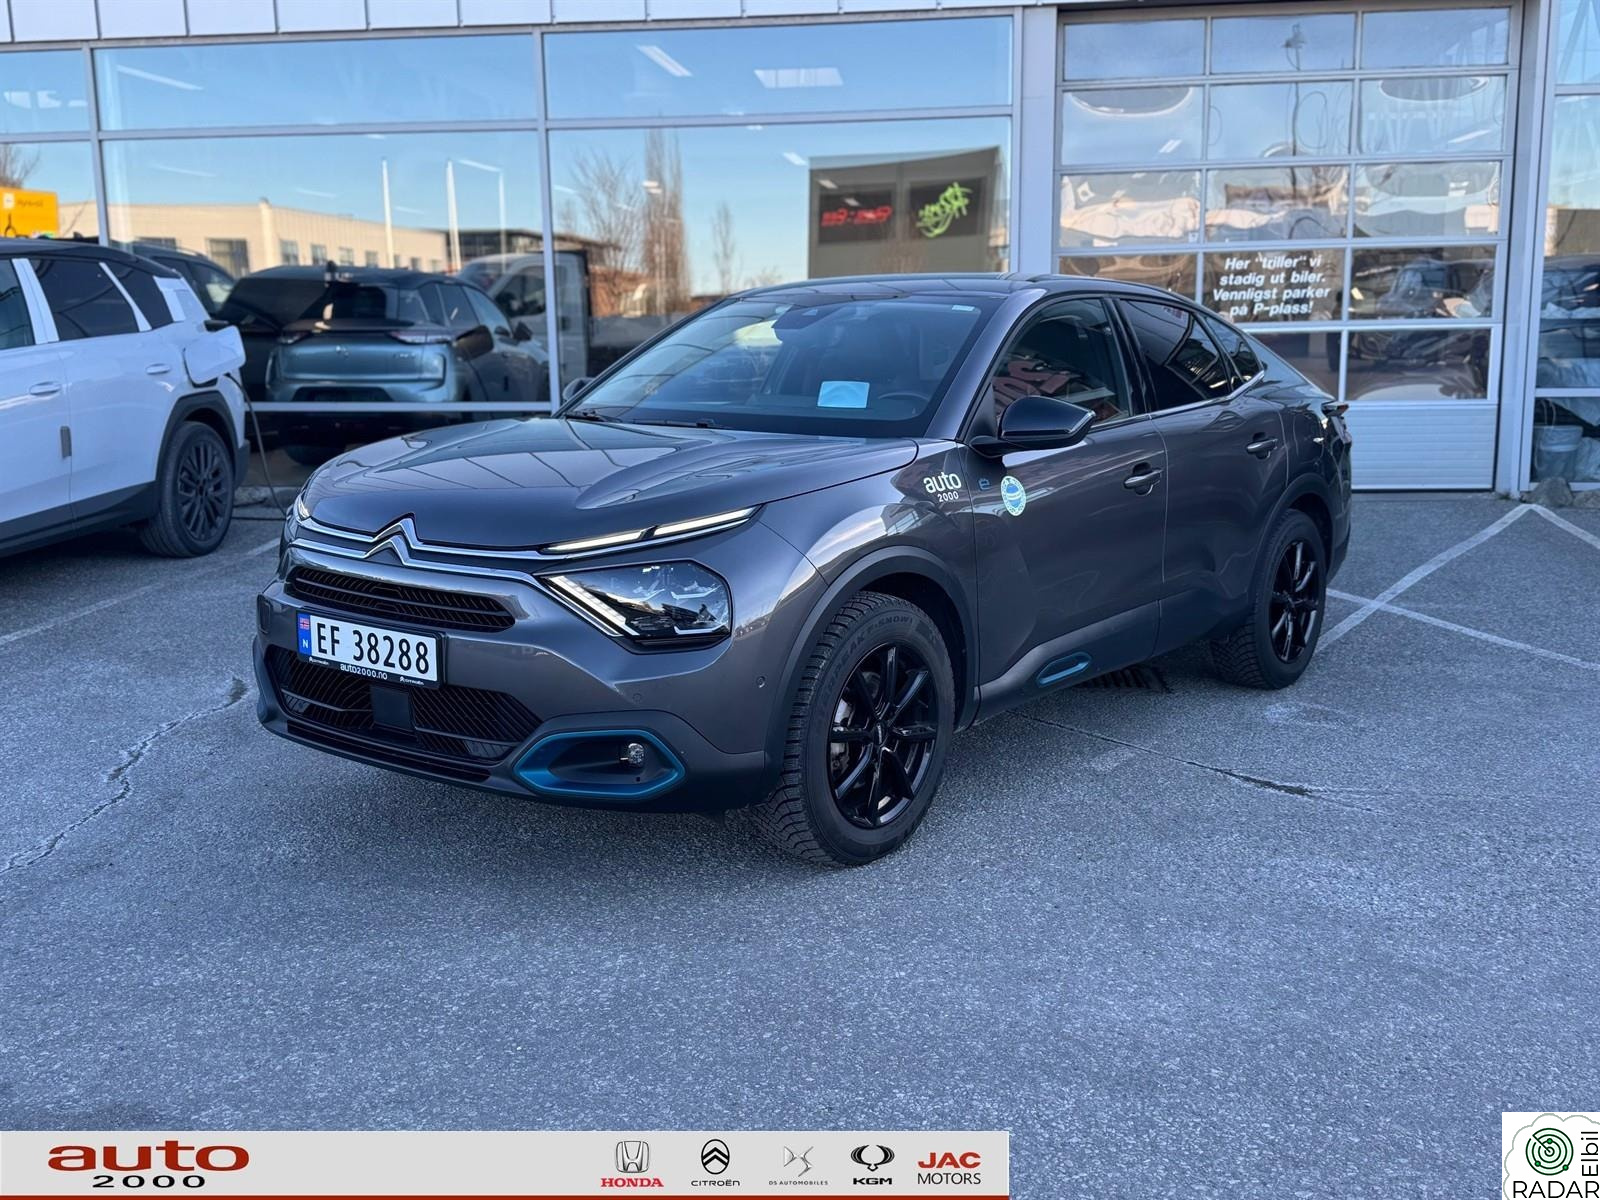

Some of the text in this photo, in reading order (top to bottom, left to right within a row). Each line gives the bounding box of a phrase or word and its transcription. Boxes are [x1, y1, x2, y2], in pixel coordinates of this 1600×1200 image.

[1224, 257, 1251, 270] Her
[1309, 254, 1322, 267] vi
[1219, 270, 1326, 287] stadig ut biler.
[1213, 285, 1331, 303] Vennligst parker
[1229, 300, 1314, 318] på P-plass!
[923, 471, 962, 494] auto
[937, 490, 960, 503] 2000
[302, 639, 309, 649] N
[317, 622, 430, 674] EF 38288
[340, 663, 388, 680] auto2000.no
